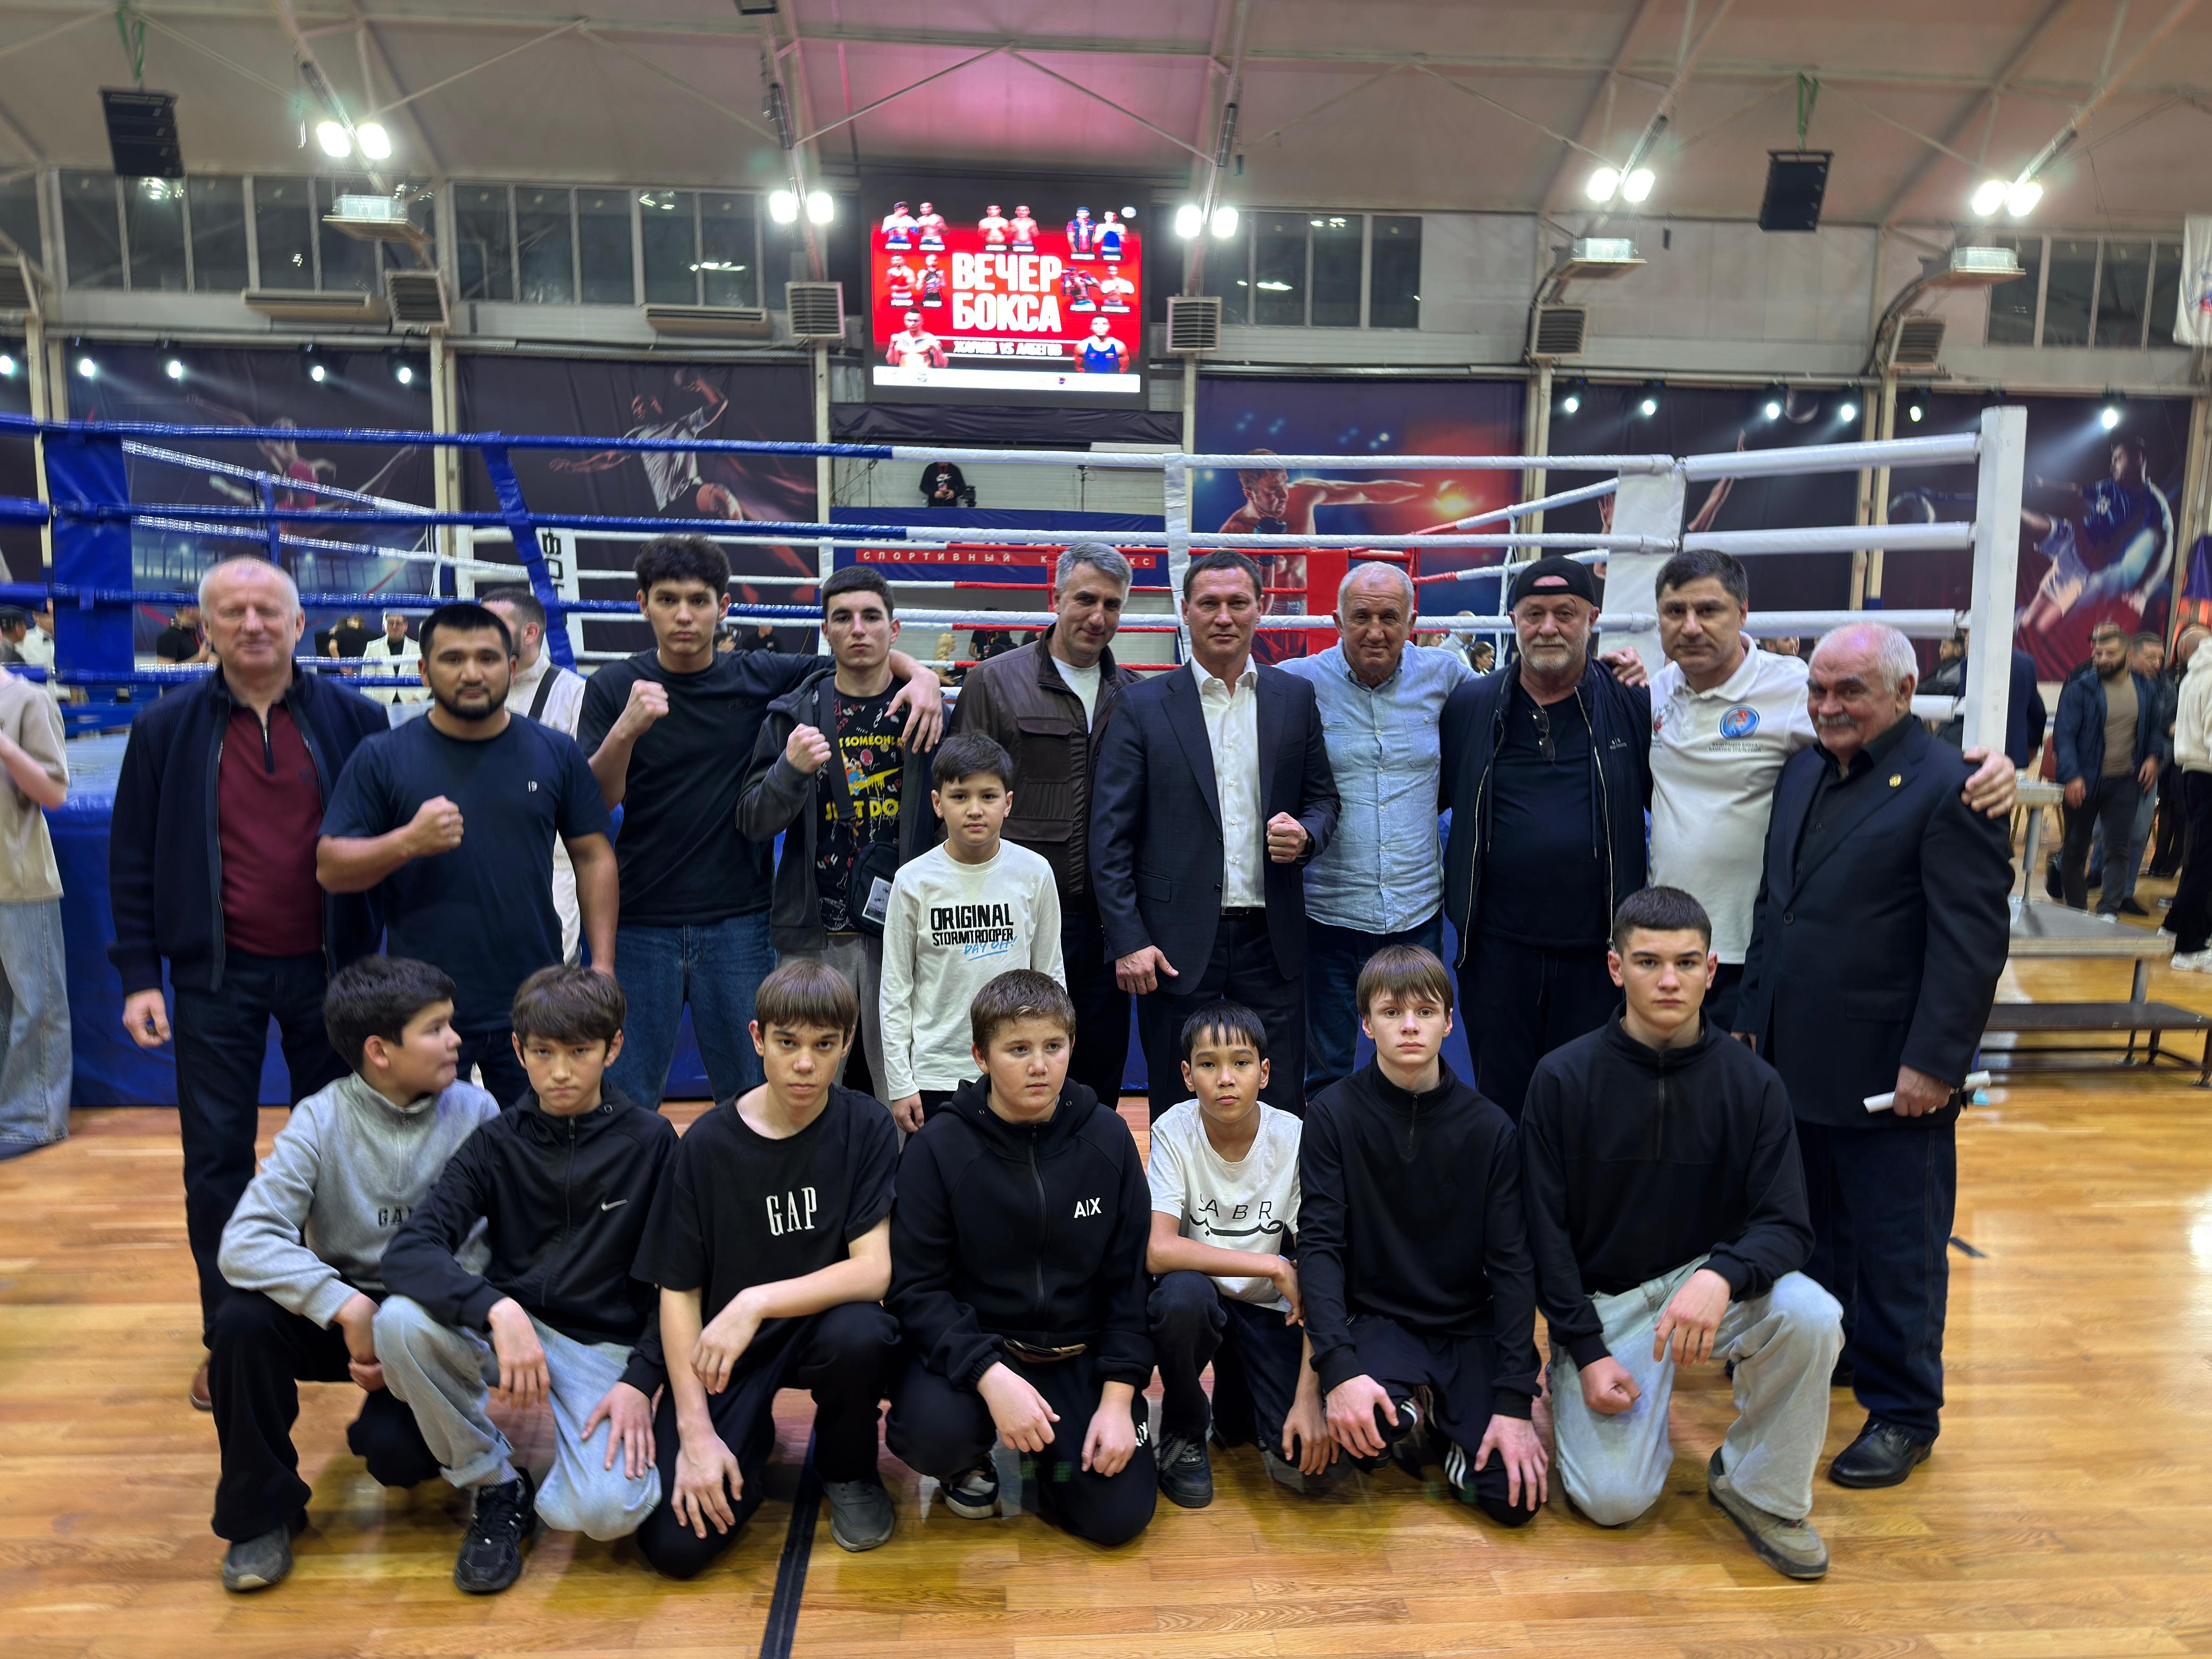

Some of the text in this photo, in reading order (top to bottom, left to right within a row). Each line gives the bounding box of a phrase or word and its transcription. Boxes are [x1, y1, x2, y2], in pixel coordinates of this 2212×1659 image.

[952, 252, 1062, 292] ВЕЧЕР
[952, 292, 1062, 332] БОКСА
[999, 341, 1015, 355] VS
[863, 551, 1011, 563] СПОРТИВНЫЙ
[931, 903, 1014, 931] ORIGINAL
[932, 928, 1014, 946] STORMTROOPER
[964, 941, 987, 955] DAY
[766, 1186, 817, 1236] GAP
